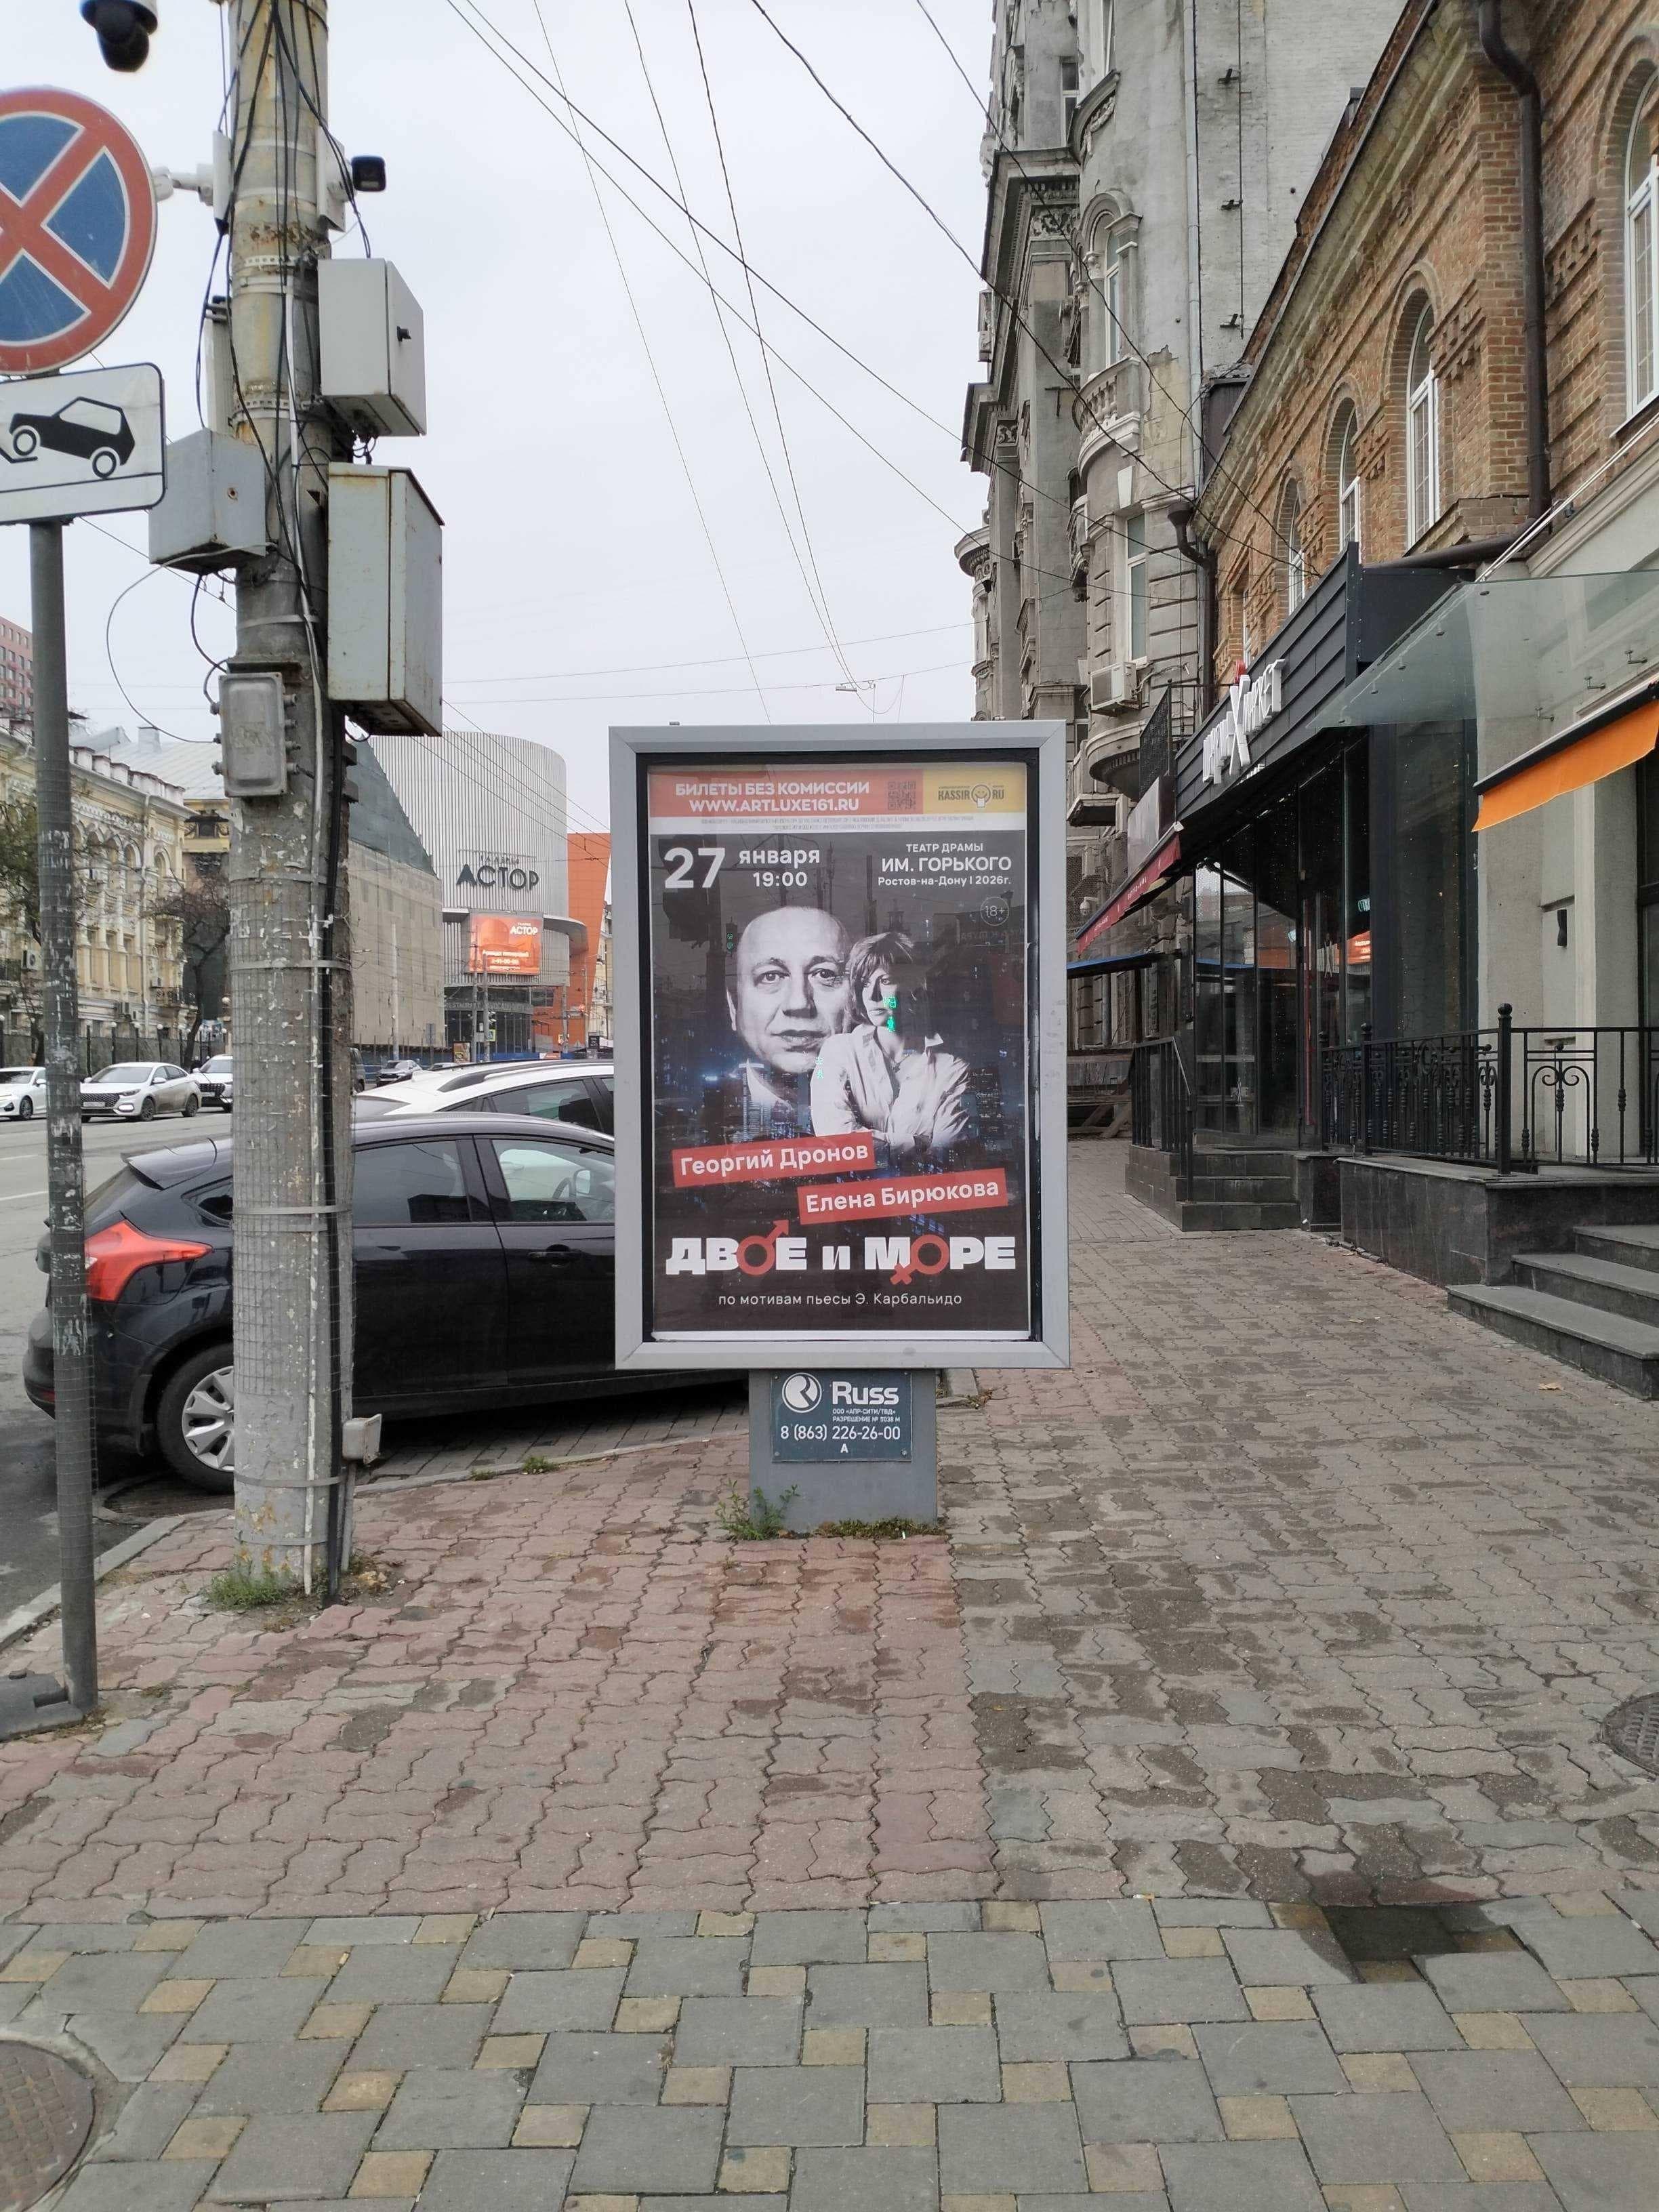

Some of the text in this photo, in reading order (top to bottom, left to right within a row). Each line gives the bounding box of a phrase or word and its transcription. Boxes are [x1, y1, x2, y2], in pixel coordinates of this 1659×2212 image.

[675, 781, 870, 796] БИЛЕТЫ БЕЗ КОМИССИИ
[689, 798, 859, 813] WWW.ARTLUXE161.RU
[906, 842, 984, 854] ТЕАТР ДРАМЫ
[664, 847, 821, 888] 27 января
[881, 856, 1012, 872] ИМ. ГОРЬКОГО
[456, 864, 540, 891] АСТОР
[753, 871, 808, 887] 19:00
[878, 876, 967, 887] Ростов-на-Дону
[975, 875, 1012, 885] 2026г.
[985, 905, 1006, 918] 18+
[509, 926, 539, 936] АСТОР
[680, 1144, 869, 1177] Георгий Дронов
[806, 1179, 1000, 1214] Елена Бирюкова
[665, 1233, 1016, 1283] ДВОЕ и МОРЕ
[718, 1292, 962, 1307] по мотивам пьесы Э. Карбальидо
[832, 1381, 899, 1406] Russ
[780, 1424, 901, 1441] 8 (863) 226-26-00
